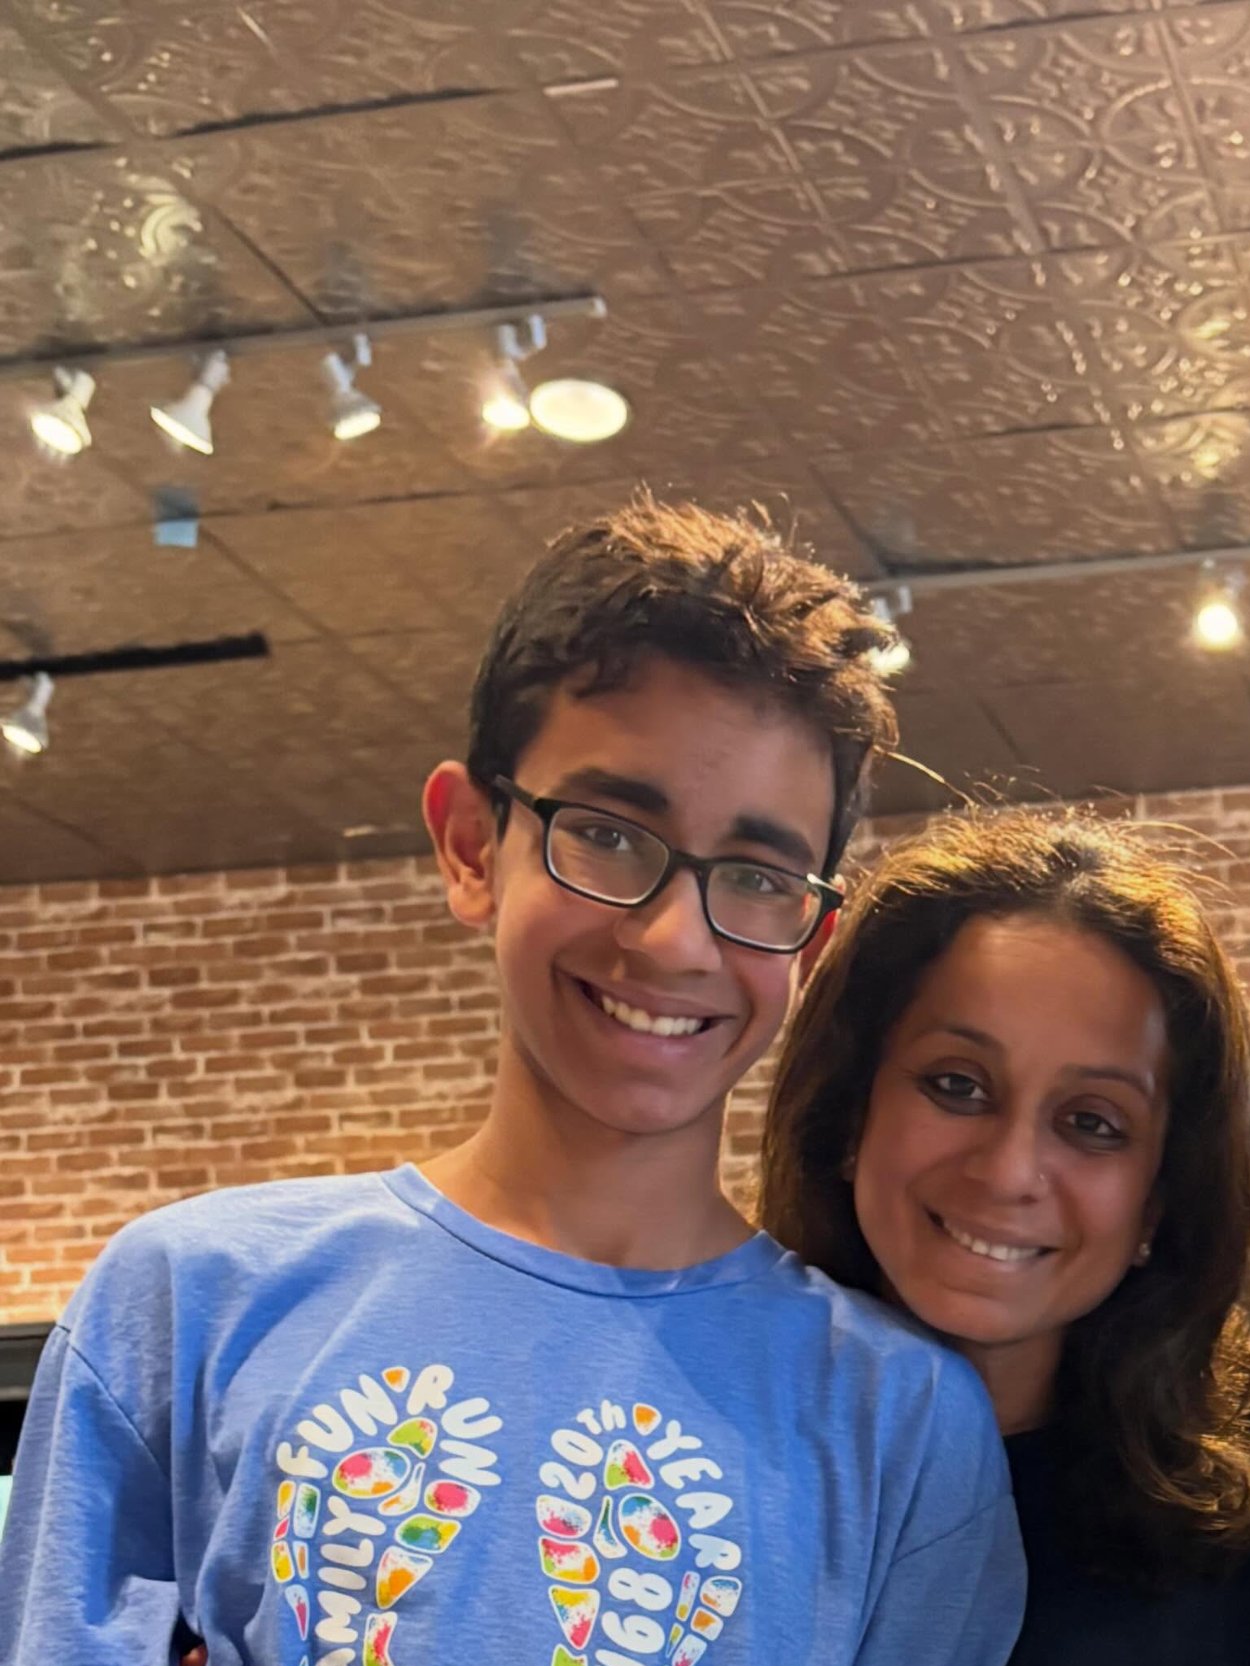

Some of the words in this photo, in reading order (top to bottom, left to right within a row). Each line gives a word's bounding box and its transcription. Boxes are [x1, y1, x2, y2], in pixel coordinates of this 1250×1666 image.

[277, 1373, 400, 1480] FUN
[406, 1364, 503, 1487] RUN
[646, 1419, 743, 1571] YEAR
